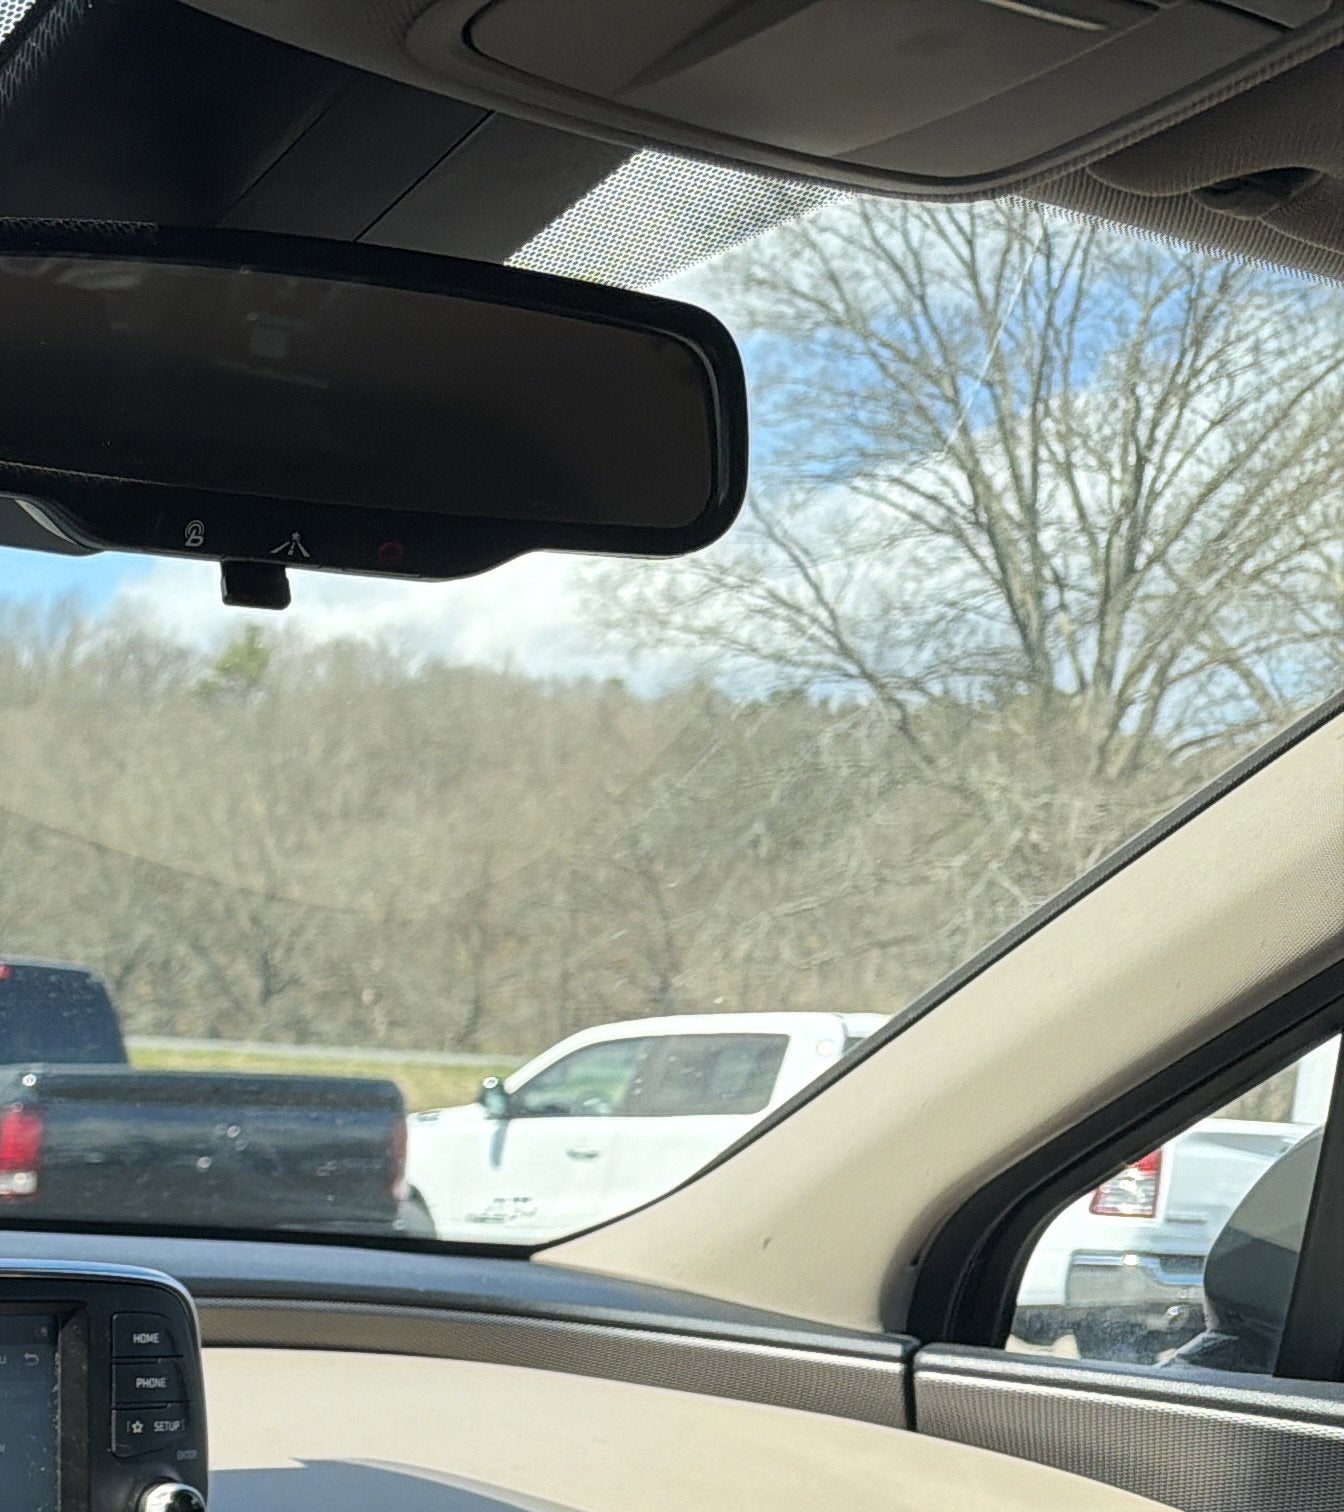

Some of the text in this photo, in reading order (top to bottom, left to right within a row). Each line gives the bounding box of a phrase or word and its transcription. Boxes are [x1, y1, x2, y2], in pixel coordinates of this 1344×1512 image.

[133, 1333, 159, 1344] HOME
[136, 1378, 166, 1388] PHONE
[154, 1421, 180, 1432] SETUP
